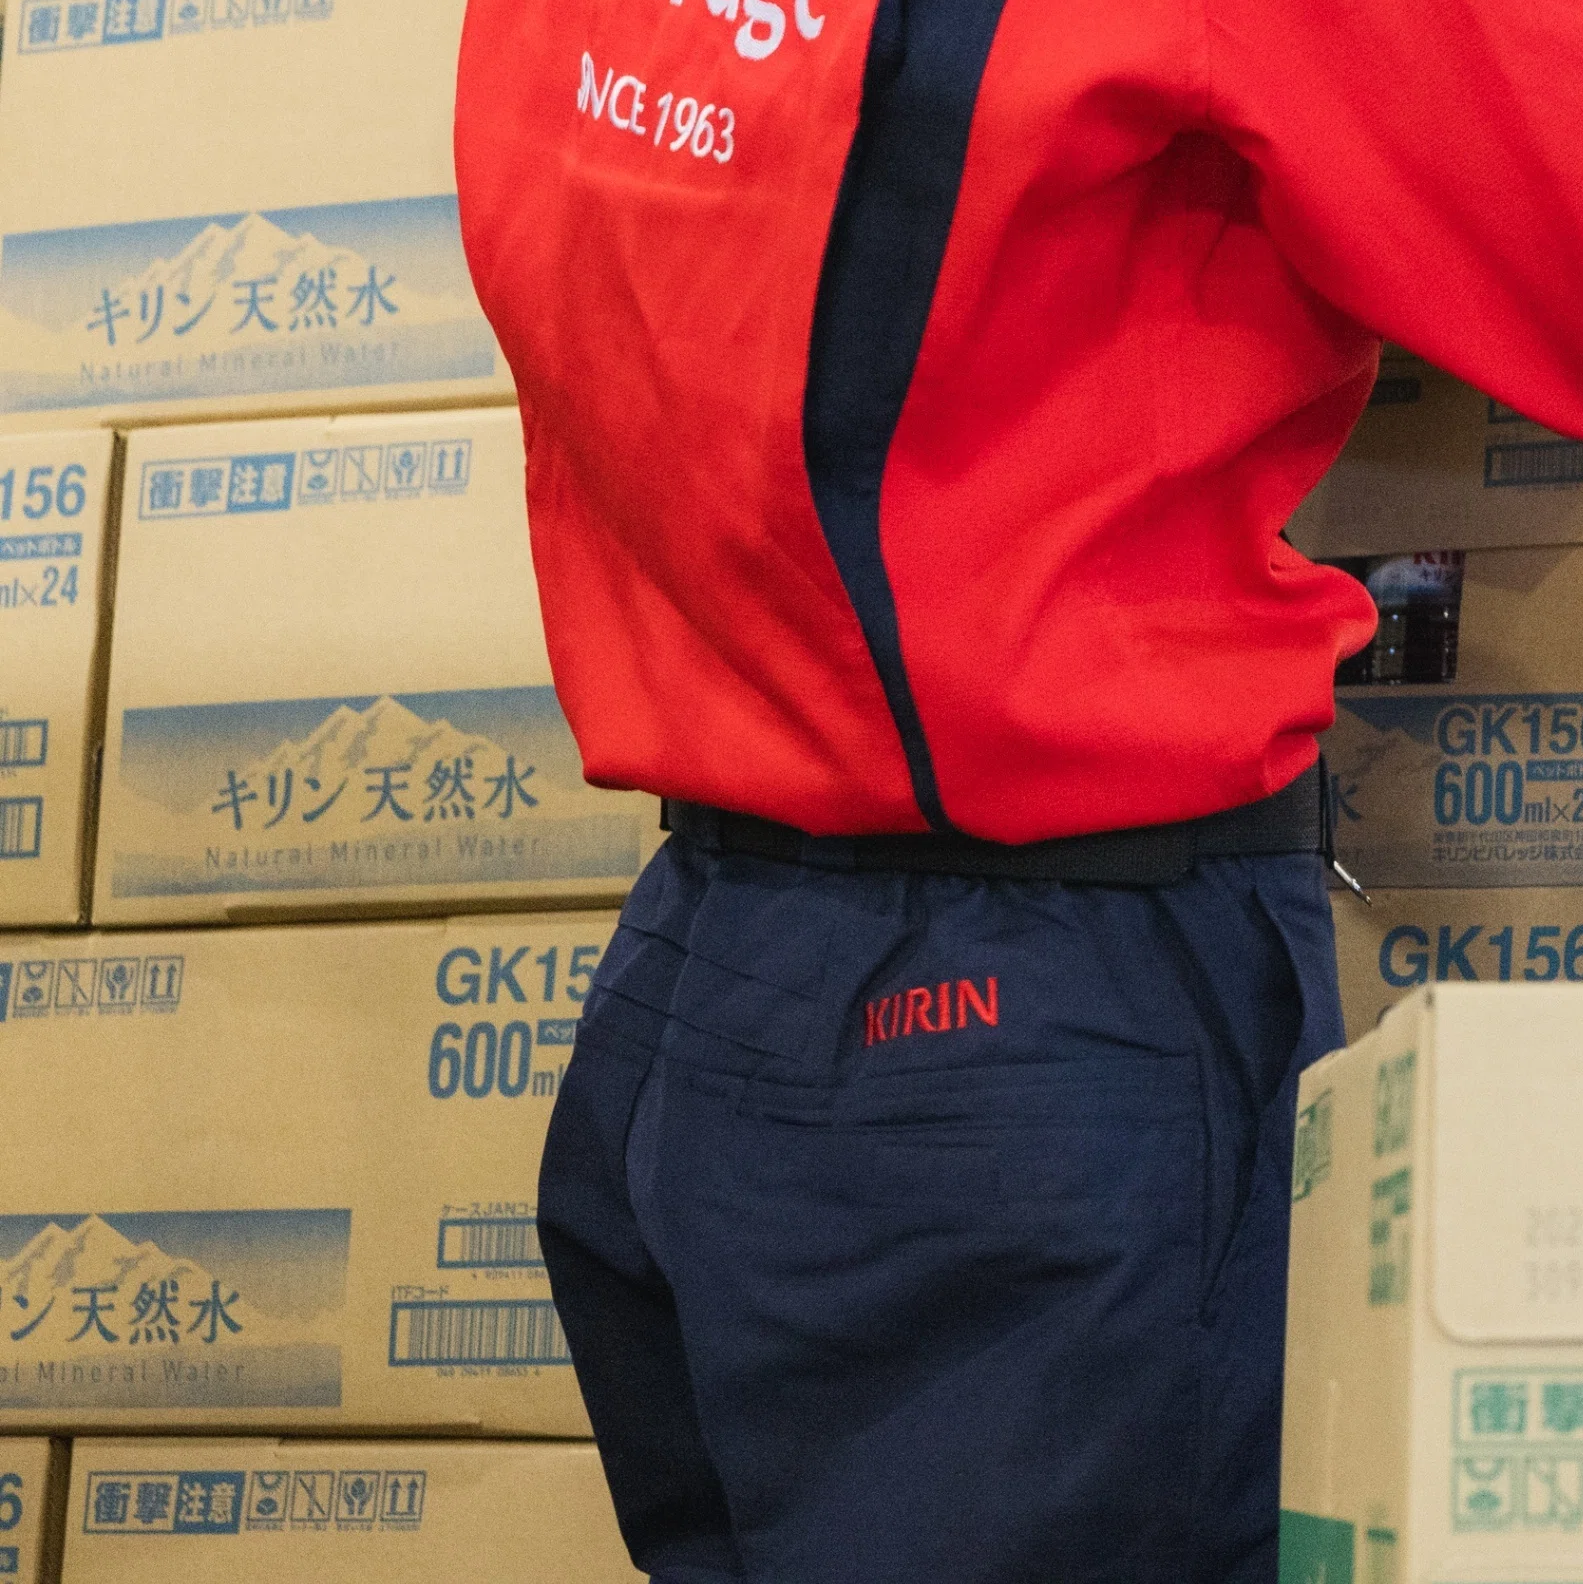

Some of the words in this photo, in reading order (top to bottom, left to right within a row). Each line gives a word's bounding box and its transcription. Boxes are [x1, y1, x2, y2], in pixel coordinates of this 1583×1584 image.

[653, 92, 736, 164] 1963
[85, 264, 400, 346] キリン天然水
[211, 754, 541, 831] キリン天然水
[204, 844, 313, 868] Natural
[329, 836, 442, 864] Mineral
[456, 834, 539, 859] Water
[864, 976, 999, 1048] KIRIN
[0, 1278, 244, 1346] ン天然水
[95, 1479, 237, 1525] 衝撃注意
